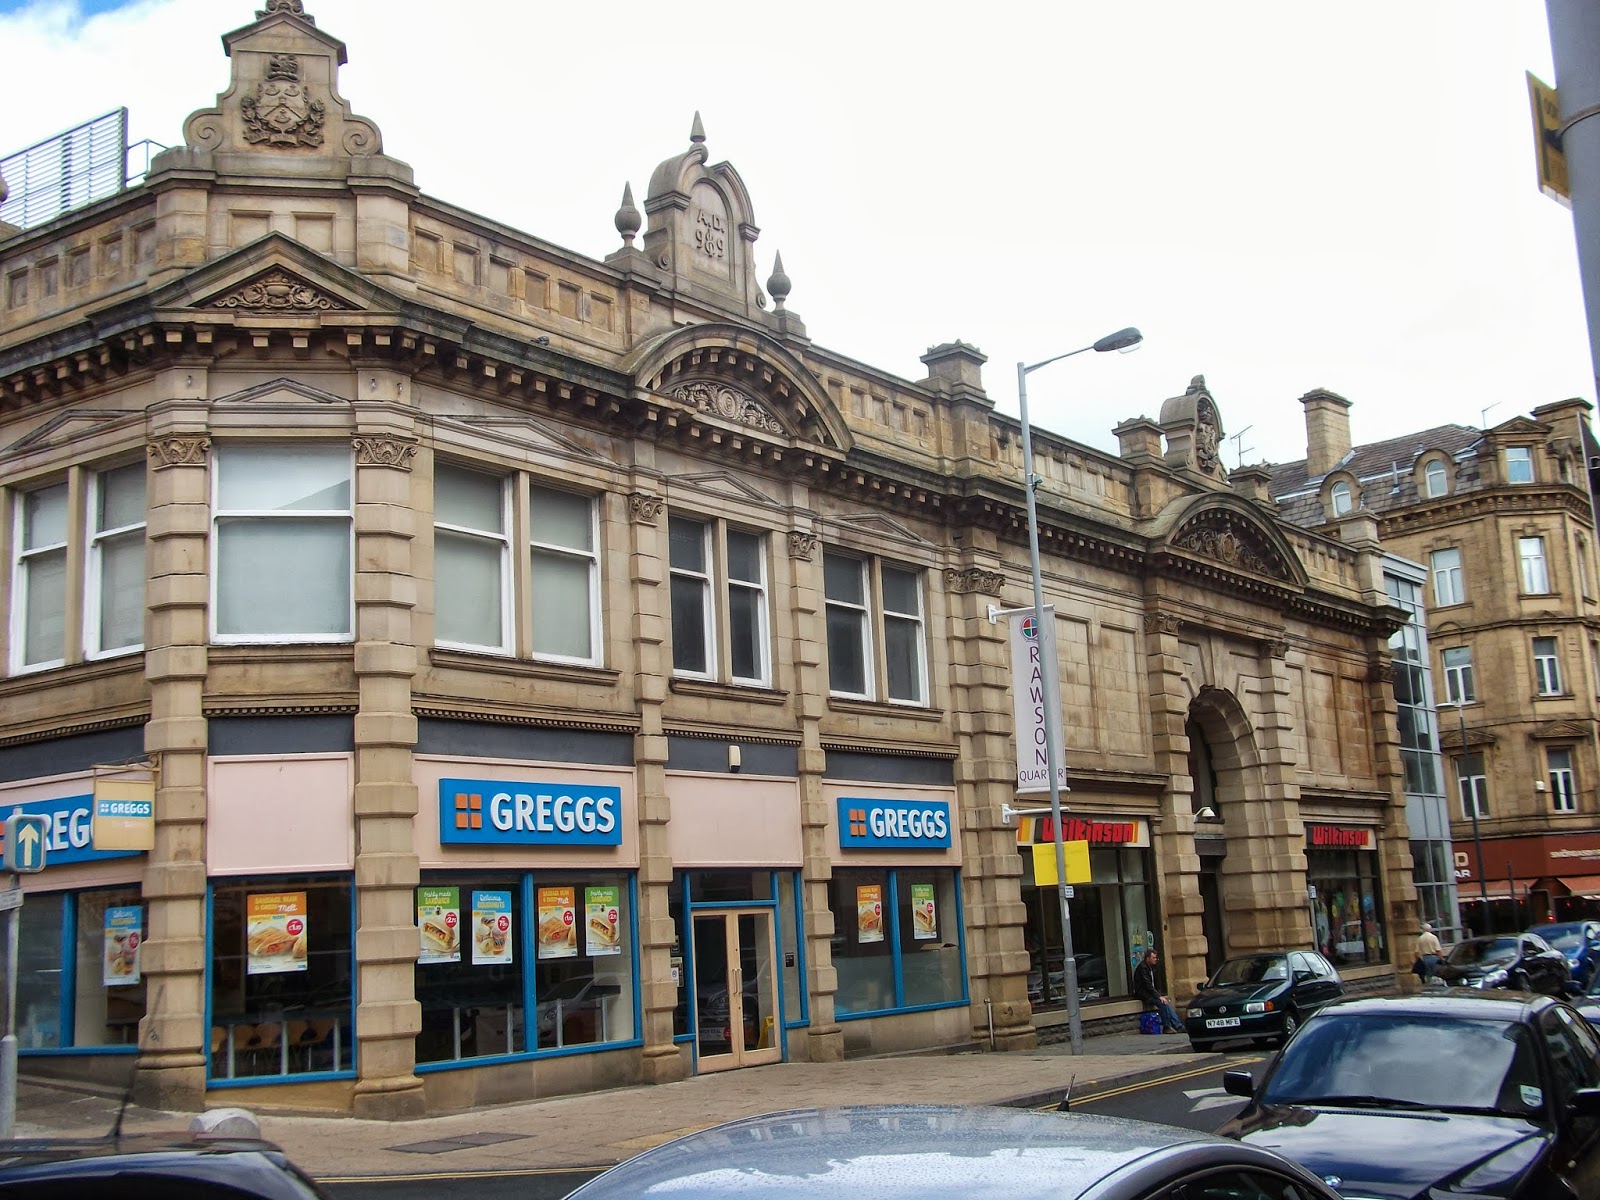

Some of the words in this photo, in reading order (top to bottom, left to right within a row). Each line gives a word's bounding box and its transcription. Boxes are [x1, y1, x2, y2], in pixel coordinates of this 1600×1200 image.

[1029, 646, 1048, 766] RAWSON
[1019, 767, 1064, 782] QUARR
[110, 802, 150, 815] GREGGS
[490, 792, 616, 833] GREGGS
[869, 807, 948, 839] GREGGS
[1042, 816, 1133, 843] Wilkinson
[1312, 825, 1369, 846] Wilkinson
